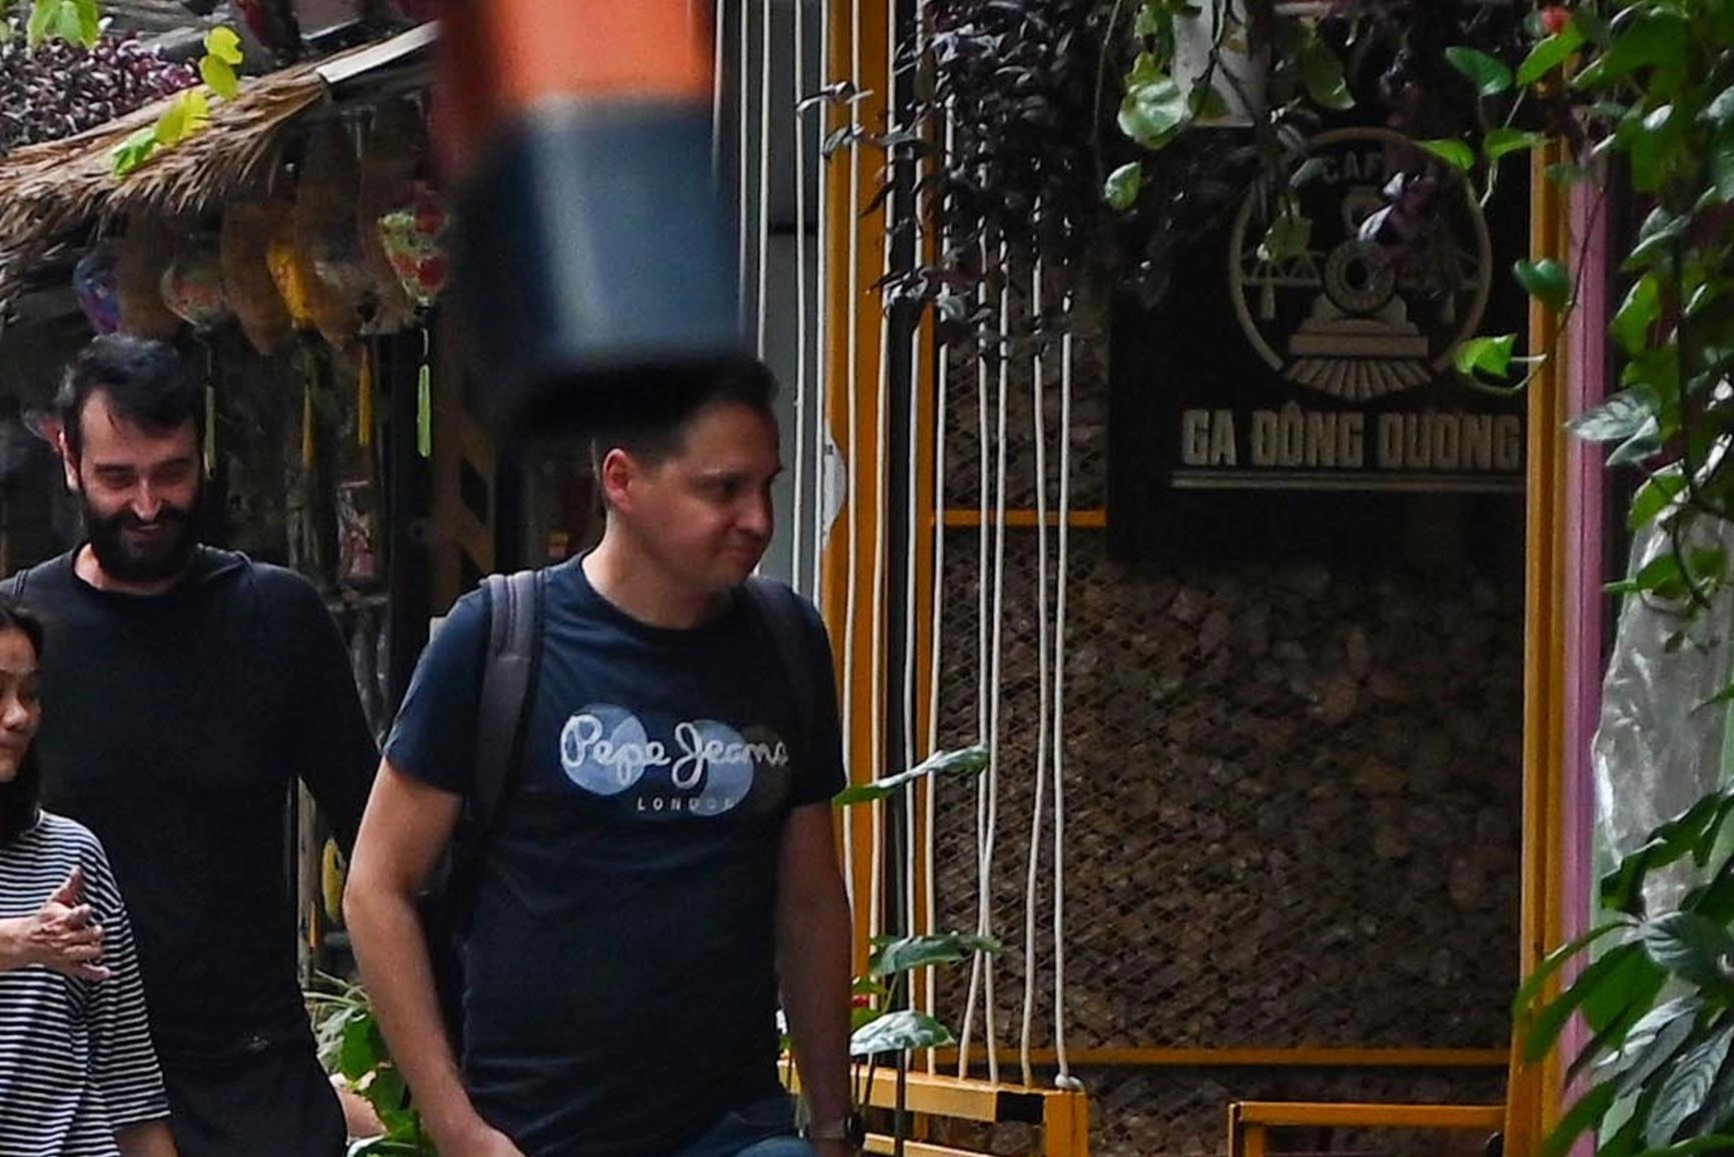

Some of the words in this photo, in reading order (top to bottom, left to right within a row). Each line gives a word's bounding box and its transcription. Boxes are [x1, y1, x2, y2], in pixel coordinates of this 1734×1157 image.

[1181, 408, 1237, 466] GA
[560, 714, 670, 786] Pepe
[671, 722, 789, 789] Jeans
